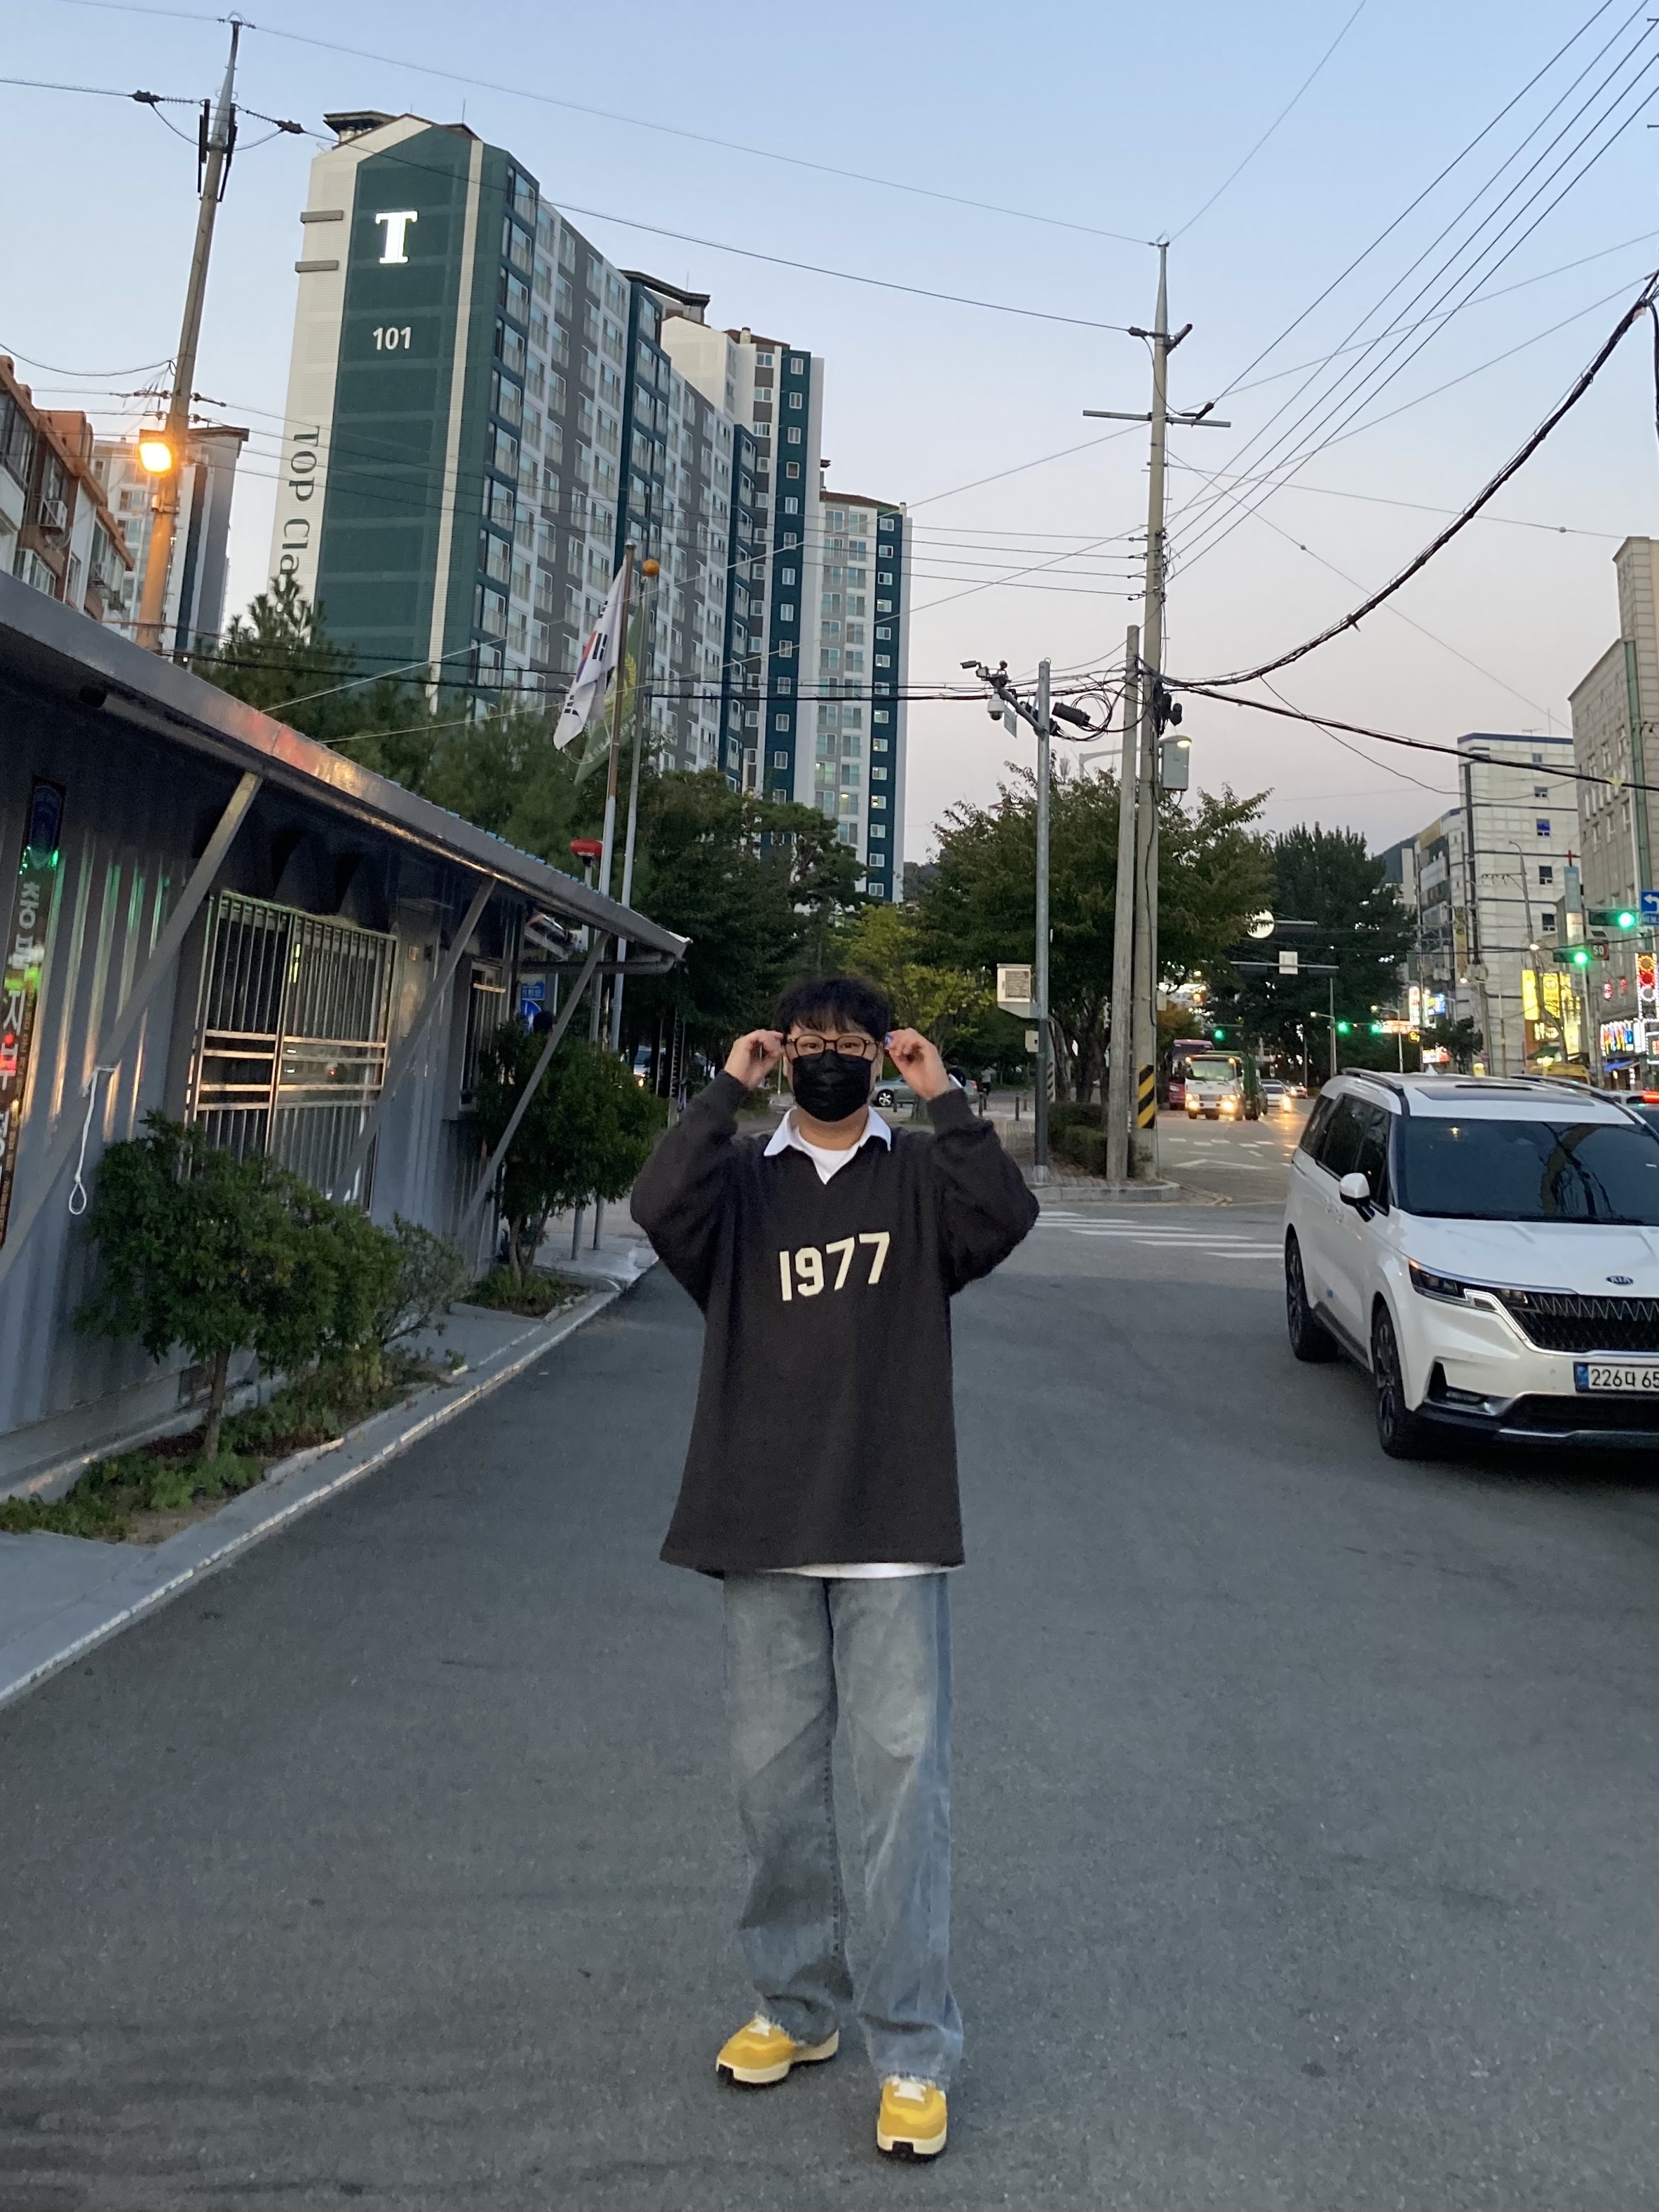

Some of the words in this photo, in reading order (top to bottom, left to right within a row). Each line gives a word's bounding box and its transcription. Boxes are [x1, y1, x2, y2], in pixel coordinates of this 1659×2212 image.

[375, 210, 418, 264] T
[373, 326, 412, 351] 101
[289, 425, 320, 502] TOP
[276, 518, 311, 609] Cla
[1592, 944, 1605, 955] 50
[779, 1230, 891, 1302] 1977
[1610, 1276, 1632, 1284] KIA
[1642, 1371, 1659, 1389] 65
